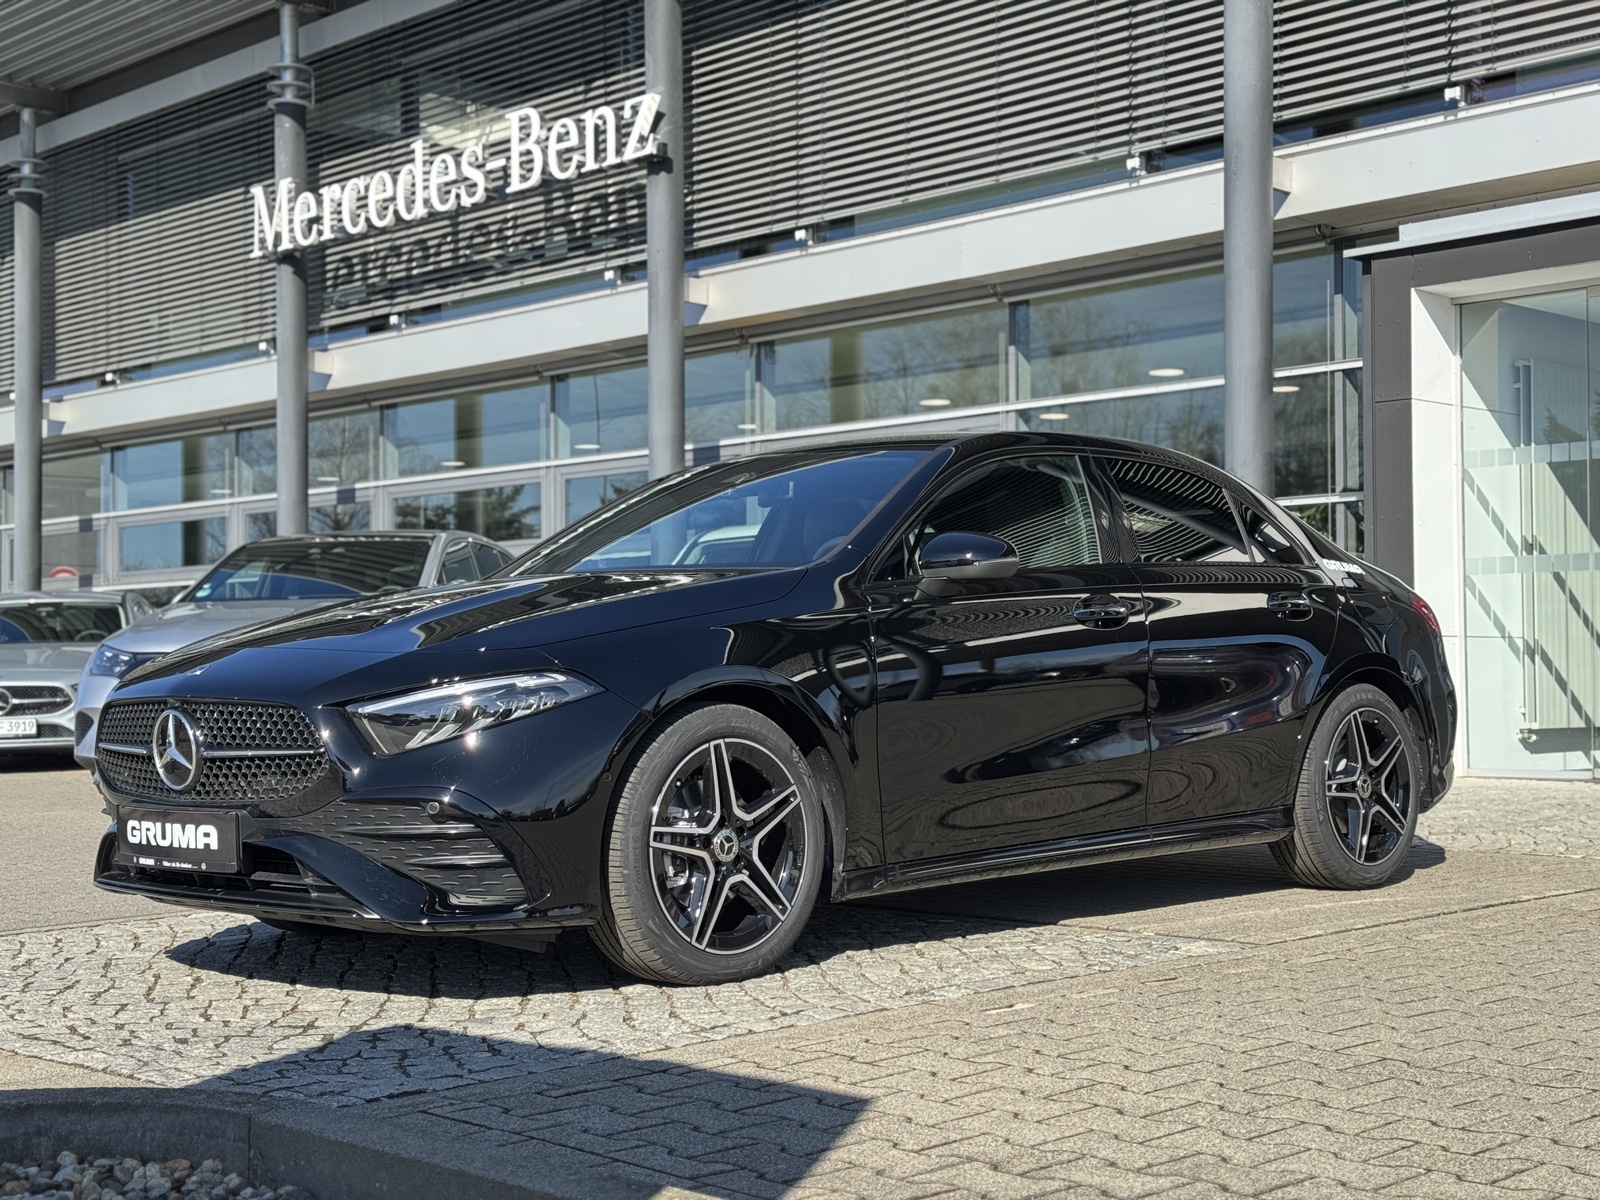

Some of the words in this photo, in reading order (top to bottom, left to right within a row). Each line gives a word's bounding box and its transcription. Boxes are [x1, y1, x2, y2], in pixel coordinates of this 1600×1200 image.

[249, 93, 661, 259] Mercedes-Benz
[1322, 558, 1366, 575] GRUMA
[7, 721, 34, 732] 3919
[126, 819, 219, 850] GRUMA
